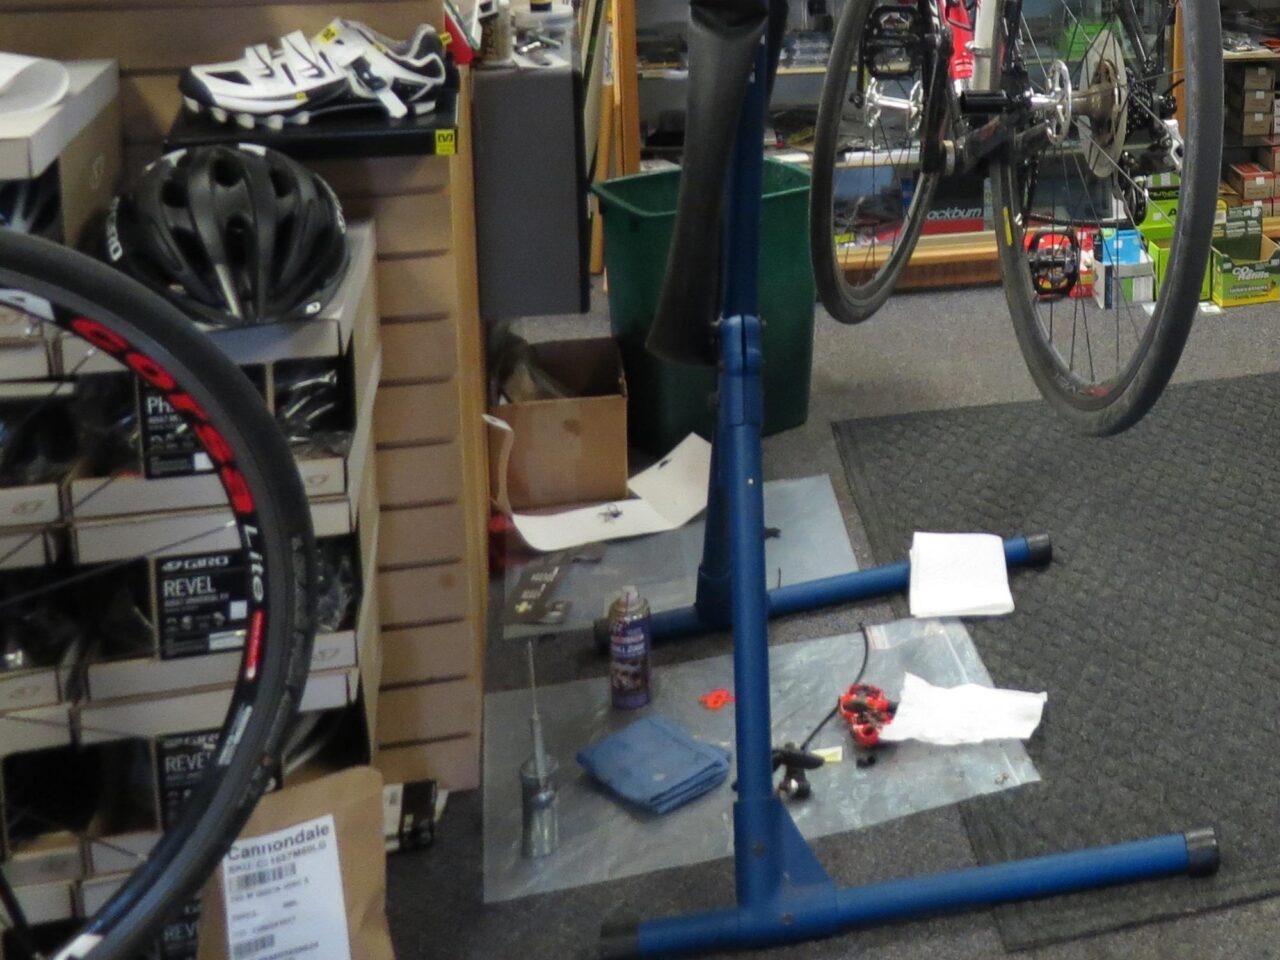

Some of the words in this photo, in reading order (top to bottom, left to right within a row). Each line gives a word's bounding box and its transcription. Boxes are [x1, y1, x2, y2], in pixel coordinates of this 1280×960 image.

[926, 206, 982, 220] ackburn
[184, 555, 229, 569] GIRO
[244, 524, 264, 602] Lite
[163, 576, 216, 597] REVEL
[164, 753, 211, 773] REVE
[228, 824, 330, 861] Cannondale
